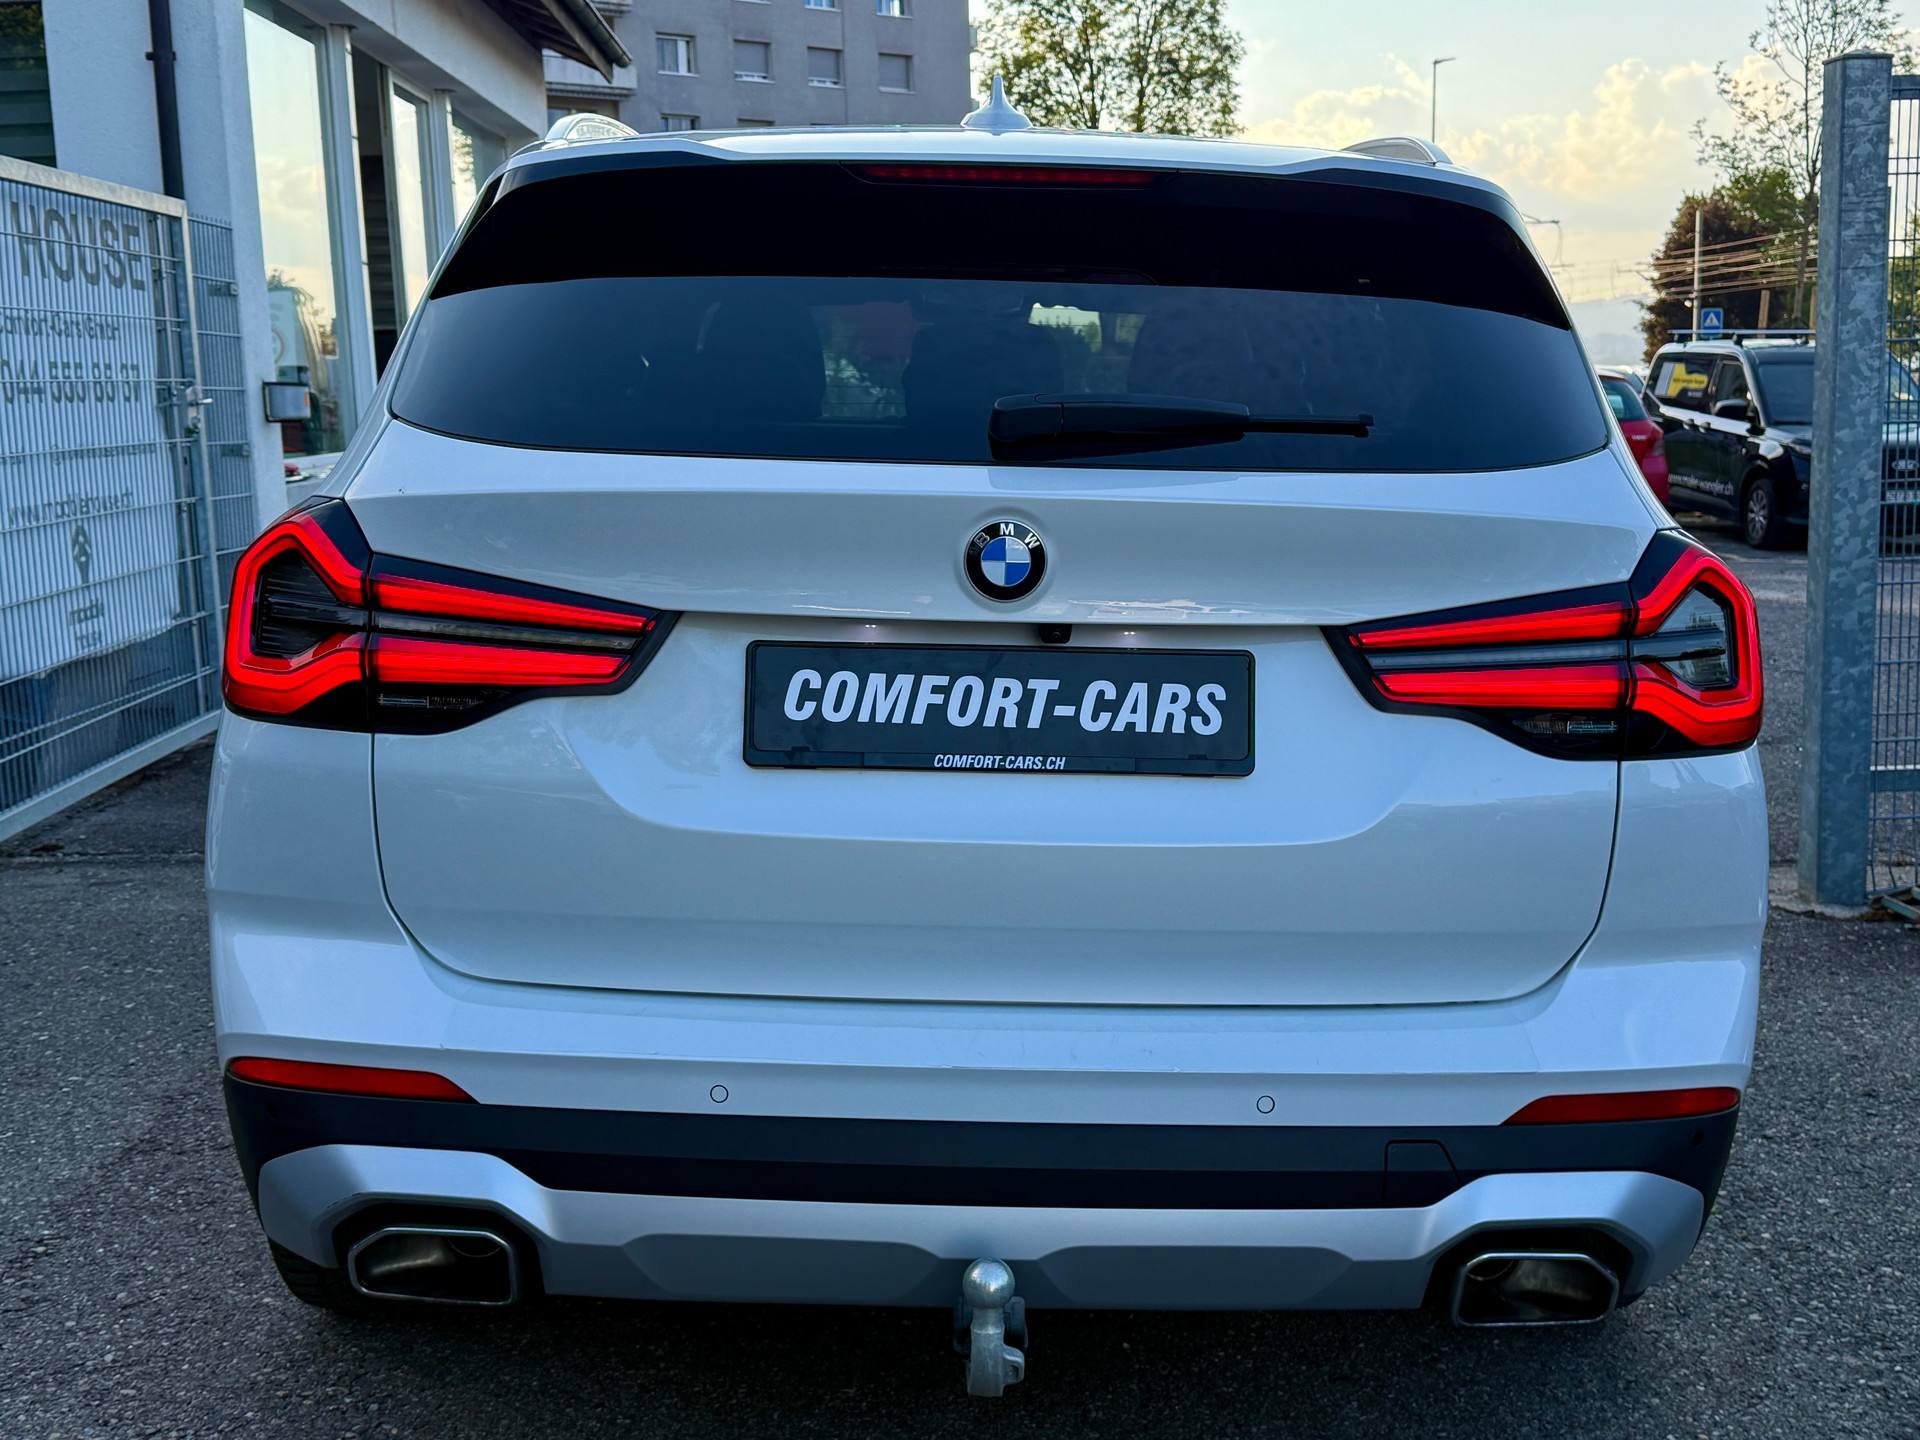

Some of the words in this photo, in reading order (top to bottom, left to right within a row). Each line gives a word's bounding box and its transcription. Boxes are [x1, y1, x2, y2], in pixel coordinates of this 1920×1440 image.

[10, 201, 146, 292] HOUSE
[48, 360, 87, 405] 555
[973, 522, 1041, 549] BMW
[783, 668, 1227, 736] COMFORT-CARS
[933, 753, 1066, 770] COMFORT-CARS.CH
